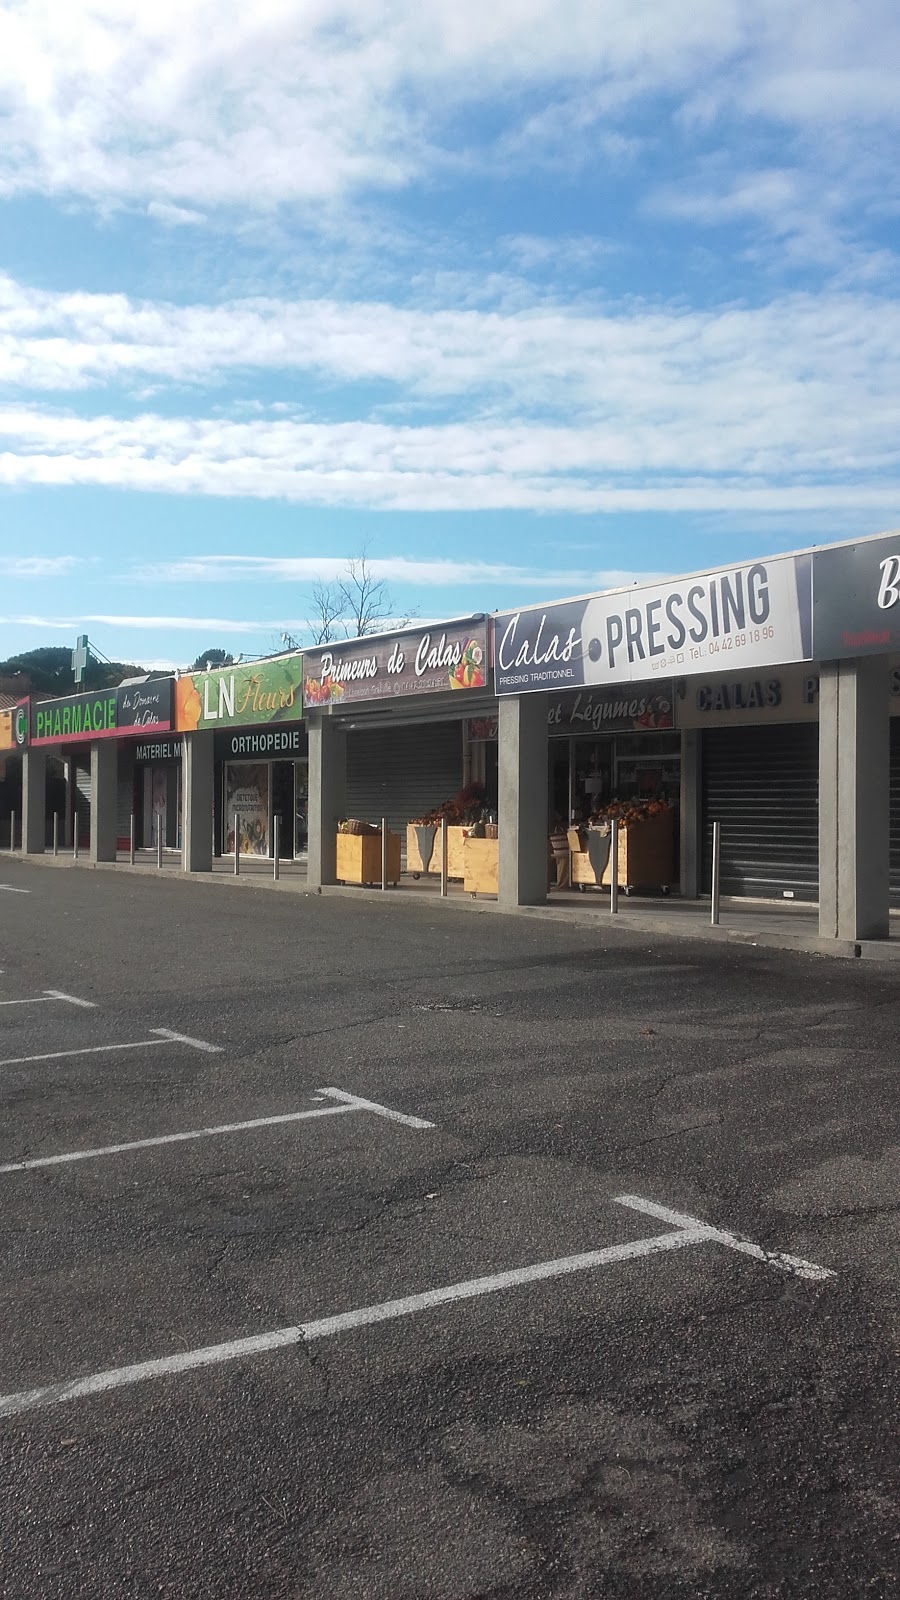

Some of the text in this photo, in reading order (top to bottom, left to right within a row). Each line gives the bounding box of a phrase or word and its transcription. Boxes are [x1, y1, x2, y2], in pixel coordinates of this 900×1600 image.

[606, 564, 770, 668] PRESSING
[498, 612, 582, 670] Calas
[708, 641, 720, 655] 04
[721, 638, 733, 651] 42
[735, 635, 747, 647] 69
[749, 630, 760, 643] 18
[762, 626, 774, 640] 96
[320, 652, 378, 686] Primeurs
[387, 643, 404, 674] de
[415, 633, 462, 676] Calas
[499, 668, 575, 685] PRESSING TRADITIONNEL
[203, 673, 295, 720] LN Fleurs
[547, 693, 647, 729] et Légumes
[696, 679, 782, 711] CALAS
[36, 698, 117, 739] PHARMACIE
[142, 709, 160, 728] Calas
[136, 743, 171, 760] MATERIEL
[231, 731, 300, 753] ORTHOPEDIE
